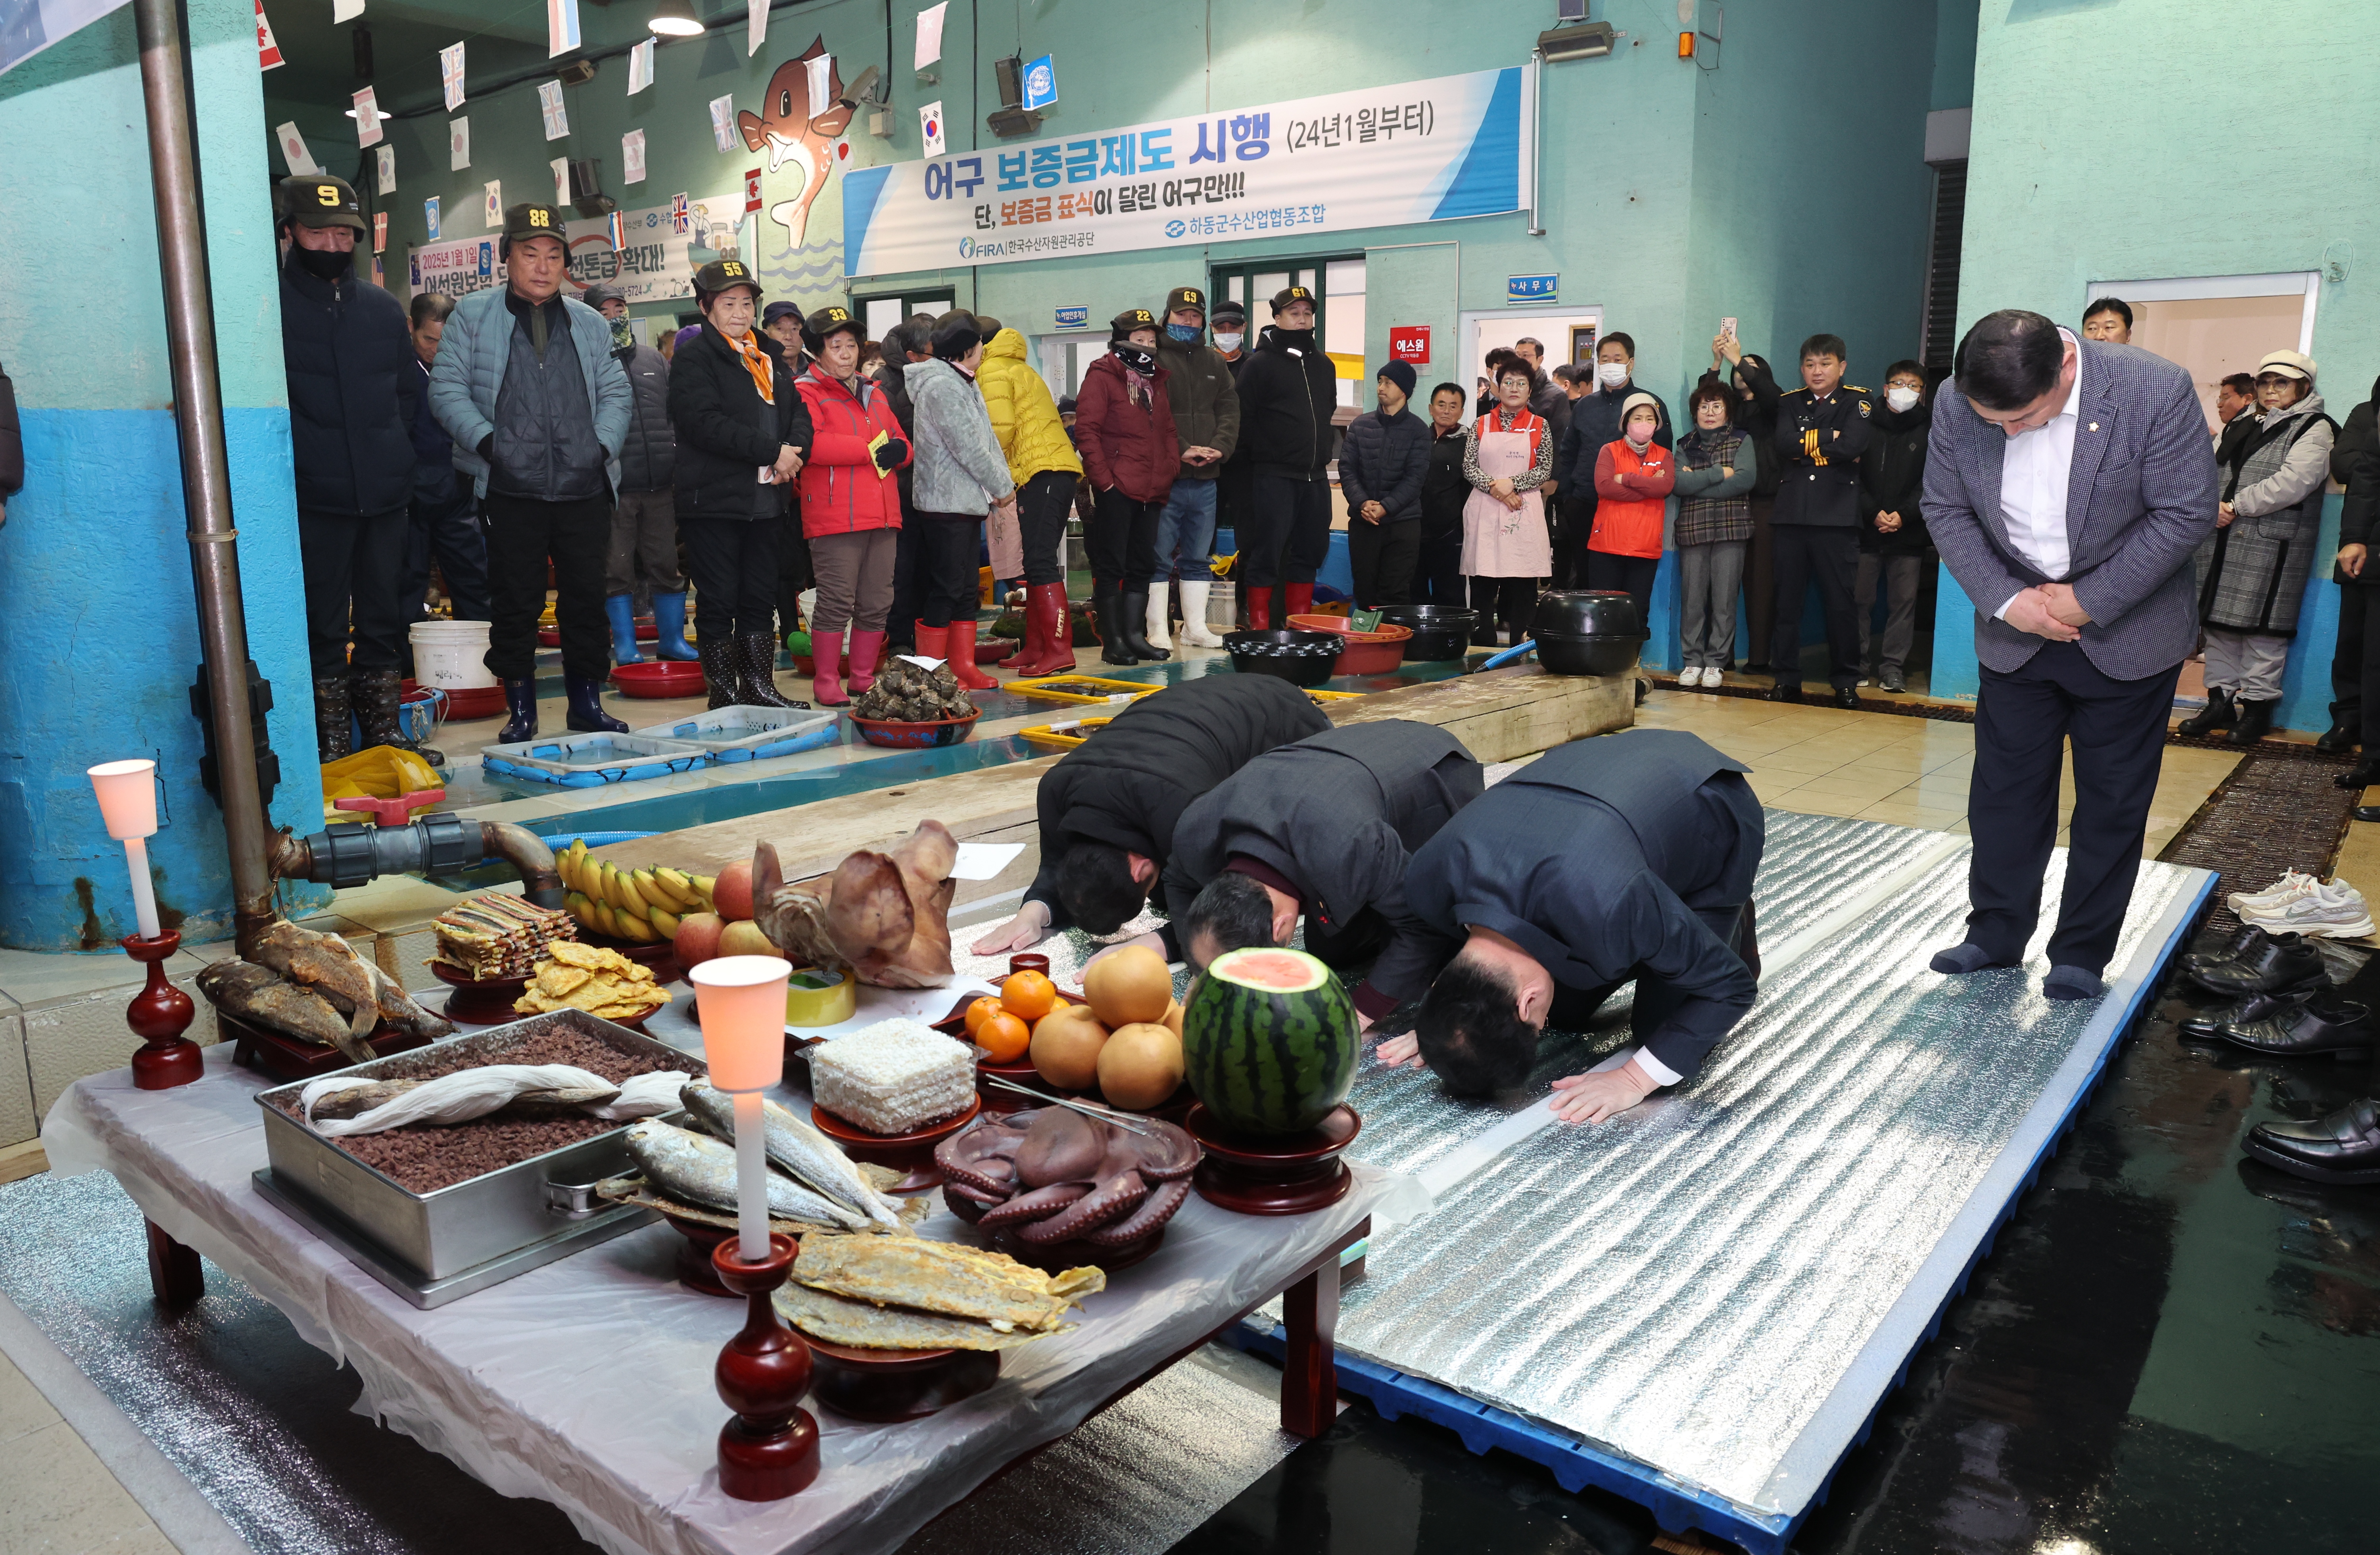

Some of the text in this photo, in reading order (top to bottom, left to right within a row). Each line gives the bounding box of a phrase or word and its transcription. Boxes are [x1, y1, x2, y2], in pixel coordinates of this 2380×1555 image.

[925, 100, 1434, 200] 어구 보증금제도 시행 (24년1월부터)
[317, 185, 340, 206] 9
[975, 171, 1245, 230] 단, 보증금 표식이 달린 어구만!!!
[530, 209, 549, 227] 88
[660, 211, 672, 224] 수협
[1190, 203, 1326, 235] 하동군수산업협동조합
[976, 243, 1004, 257] FIRA
[1008, 232, 1095, 254] 한국수산자원관리공단
[423, 251, 449, 269] 2025년
[451, 249, 463, 266] 1월
[569, 243, 665, 282] 전톤급 확대!
[722, 261, 744, 277] 55
[1184, 291, 1197, 303] 49
[1292, 288, 1306, 298] 61
[828, 308, 847, 321] 33
[1061, 310, 1086, 320] 어업인휴게실
[1136, 310, 1151, 321] 22
[1396, 338, 1424, 352] 에스원
[1055, 608, 1065, 639] ZACTAS
